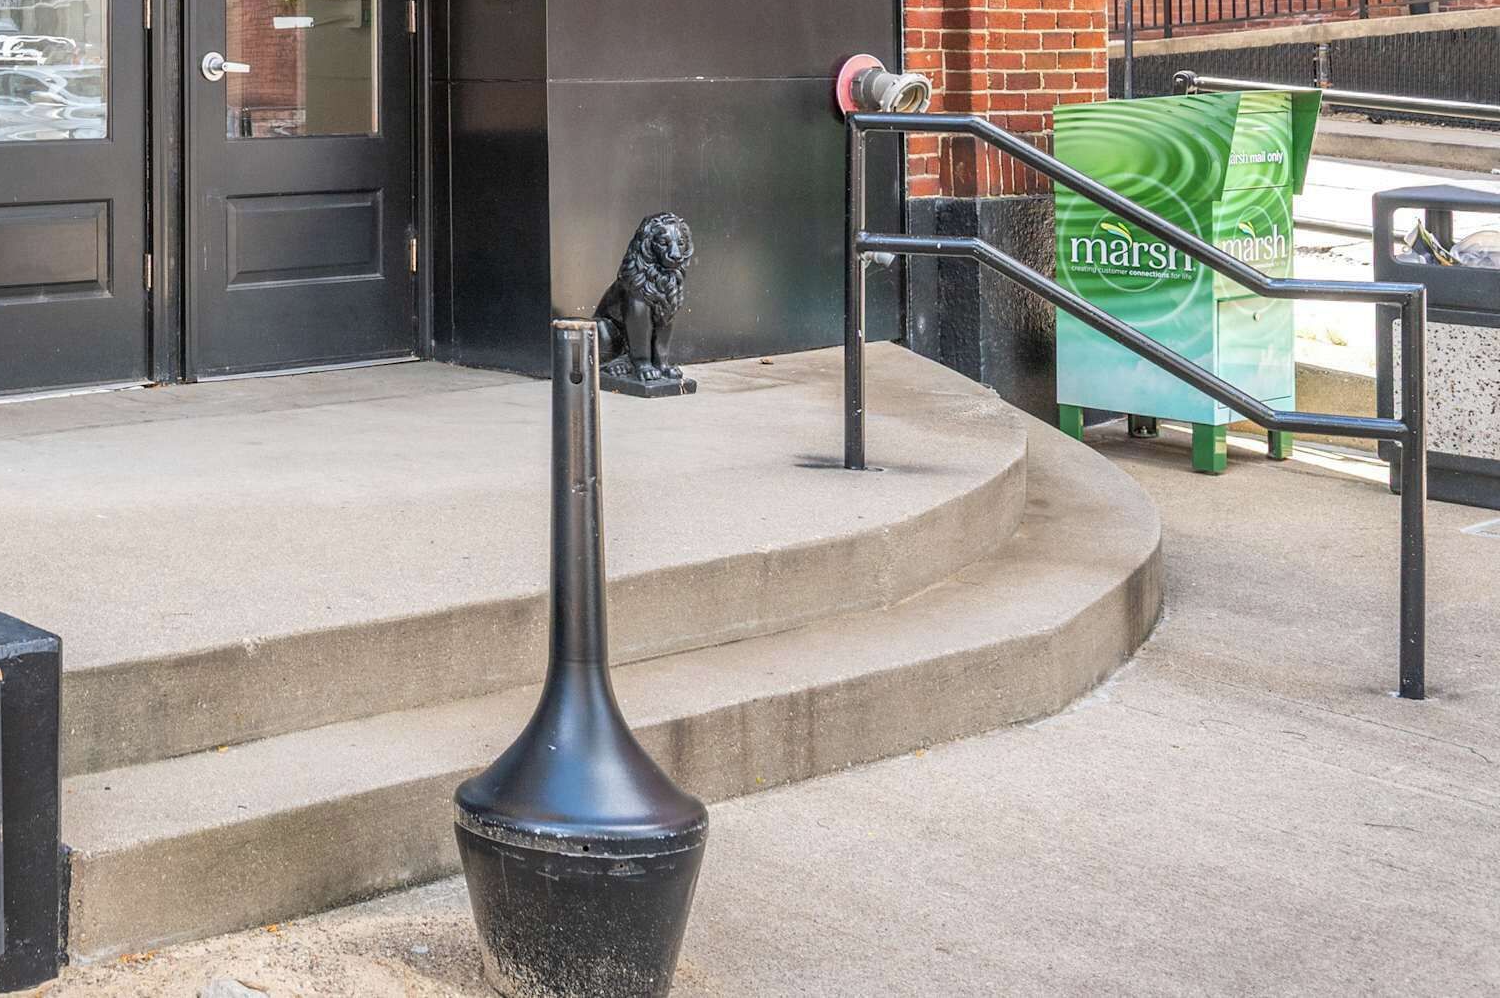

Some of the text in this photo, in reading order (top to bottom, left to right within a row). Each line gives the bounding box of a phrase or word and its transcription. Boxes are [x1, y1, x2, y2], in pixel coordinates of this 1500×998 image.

[1229, 150, 1284, 165] arsh mail only
[1222, 224, 1288, 262] marsh
[1071, 266, 1096, 274] creating
[1098, 267, 1128, 275] customer
[1129, 270, 1170, 279] connections
